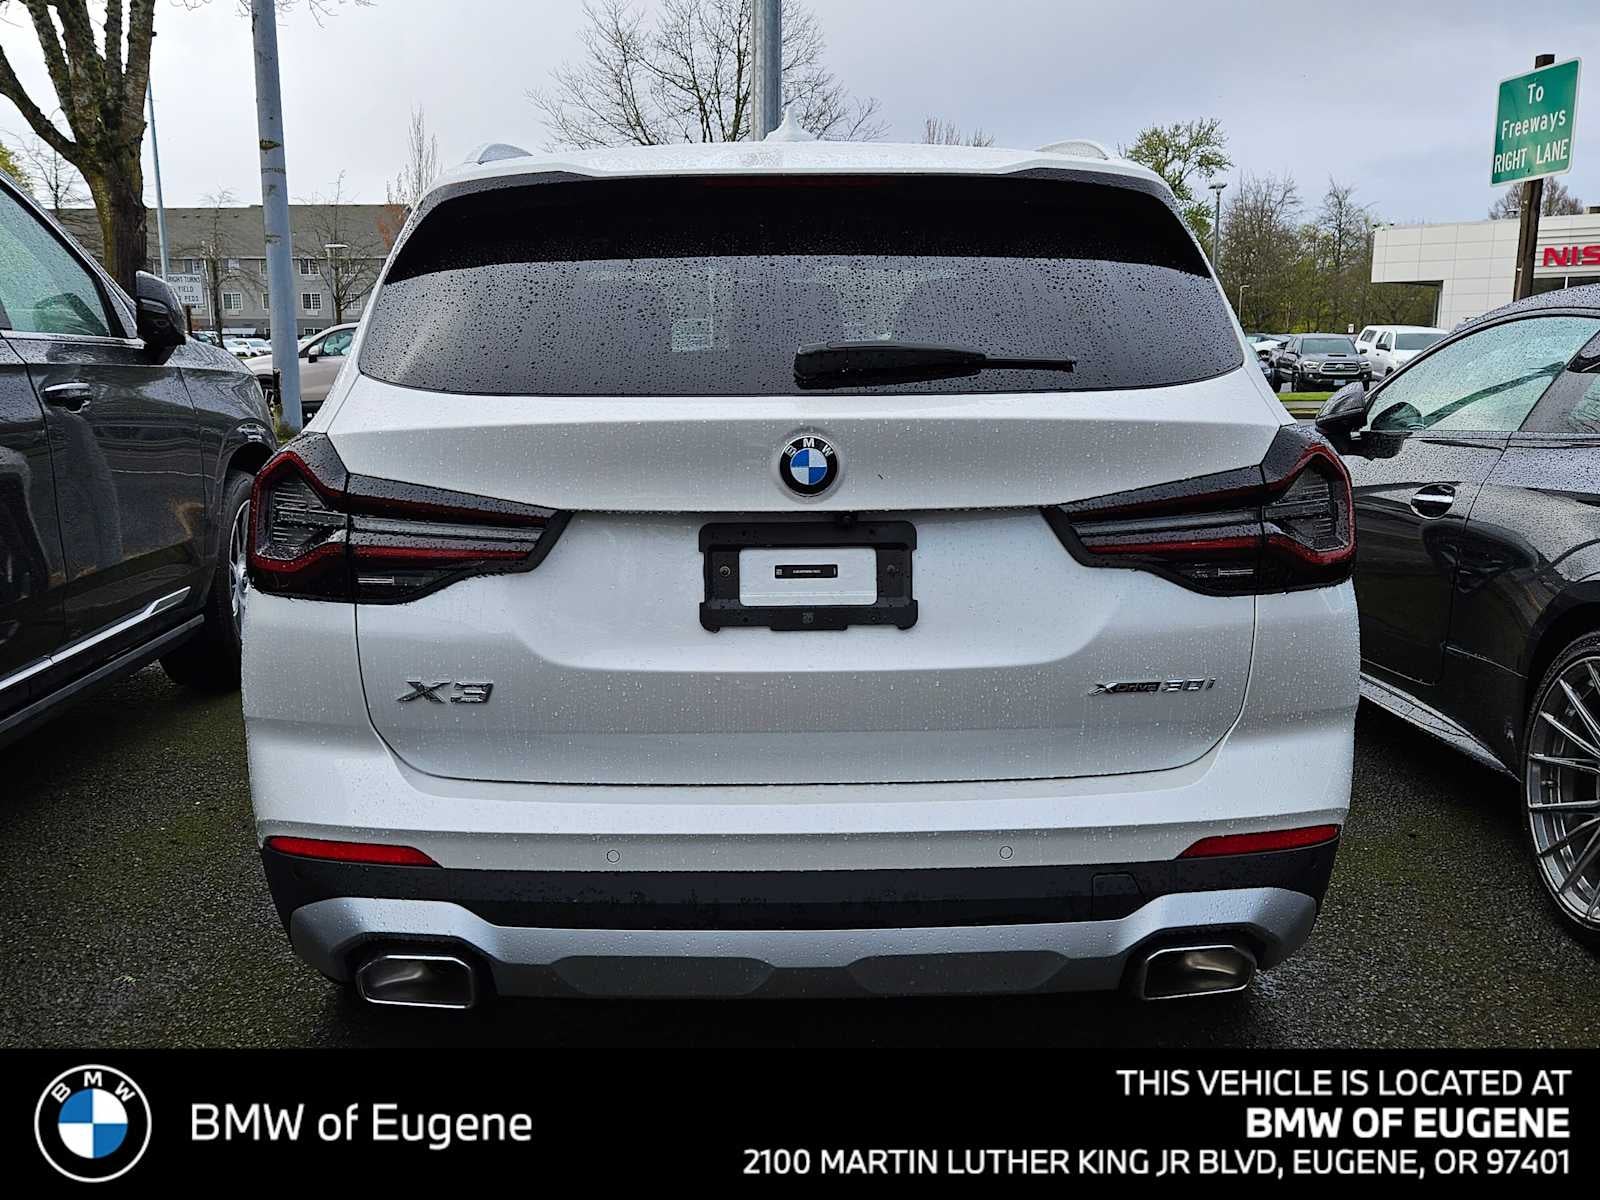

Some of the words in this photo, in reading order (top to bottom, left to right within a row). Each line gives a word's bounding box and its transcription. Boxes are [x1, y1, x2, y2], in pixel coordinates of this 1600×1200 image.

[1528, 83, 1544, 104] To
[1502, 110, 1566, 140] Freeways
[1494, 148, 1528, 173] RIGHT
[1536, 139, 1569, 165] LANE
[785, 438, 834, 457] BMW
[396, 680, 493, 704] X3
